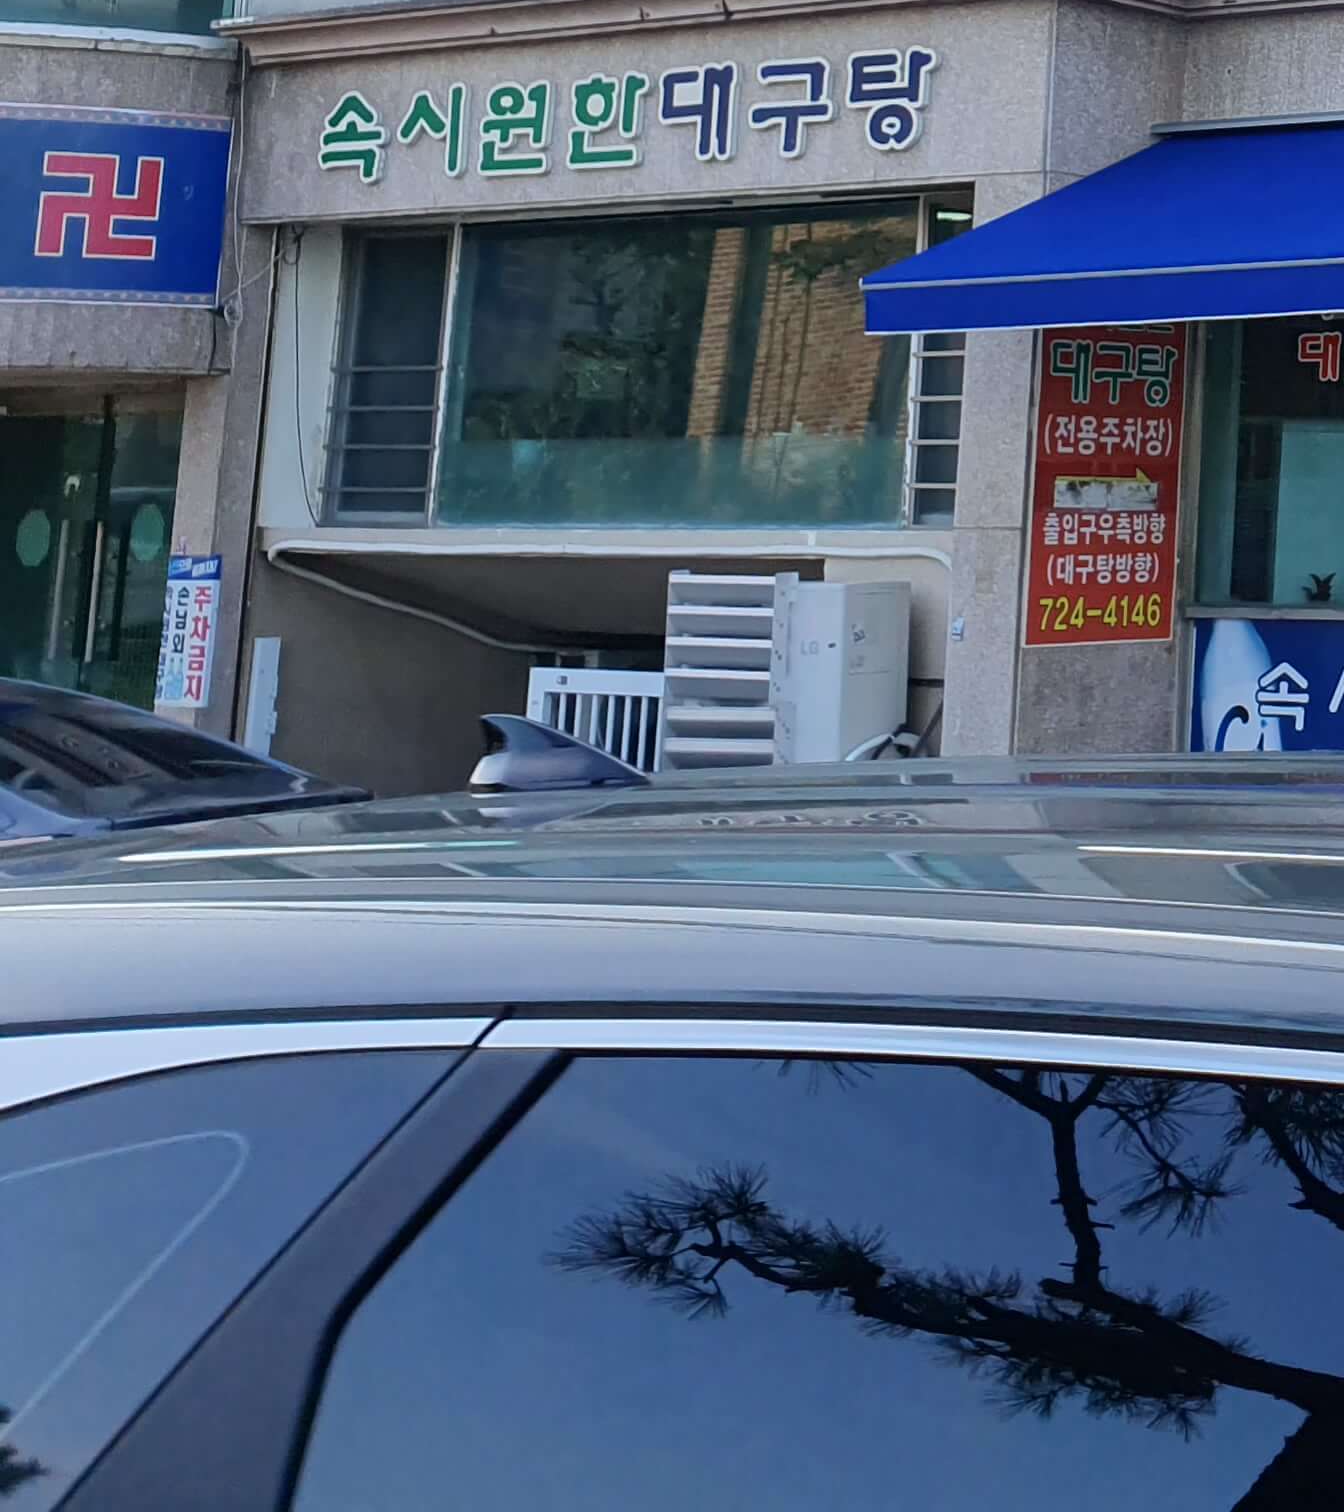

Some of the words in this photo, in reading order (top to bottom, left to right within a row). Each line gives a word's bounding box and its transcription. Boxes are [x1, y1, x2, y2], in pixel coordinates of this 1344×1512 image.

[1050, 339, 1178, 408] 대구탕
[1044, 413, 1173, 457] (전용주차장)
[1047, 553, 1160, 586] (대구탕방향)
[1039, 593, 1162, 631] 724-4146
[184, 585, 213, 701] 주차금지
